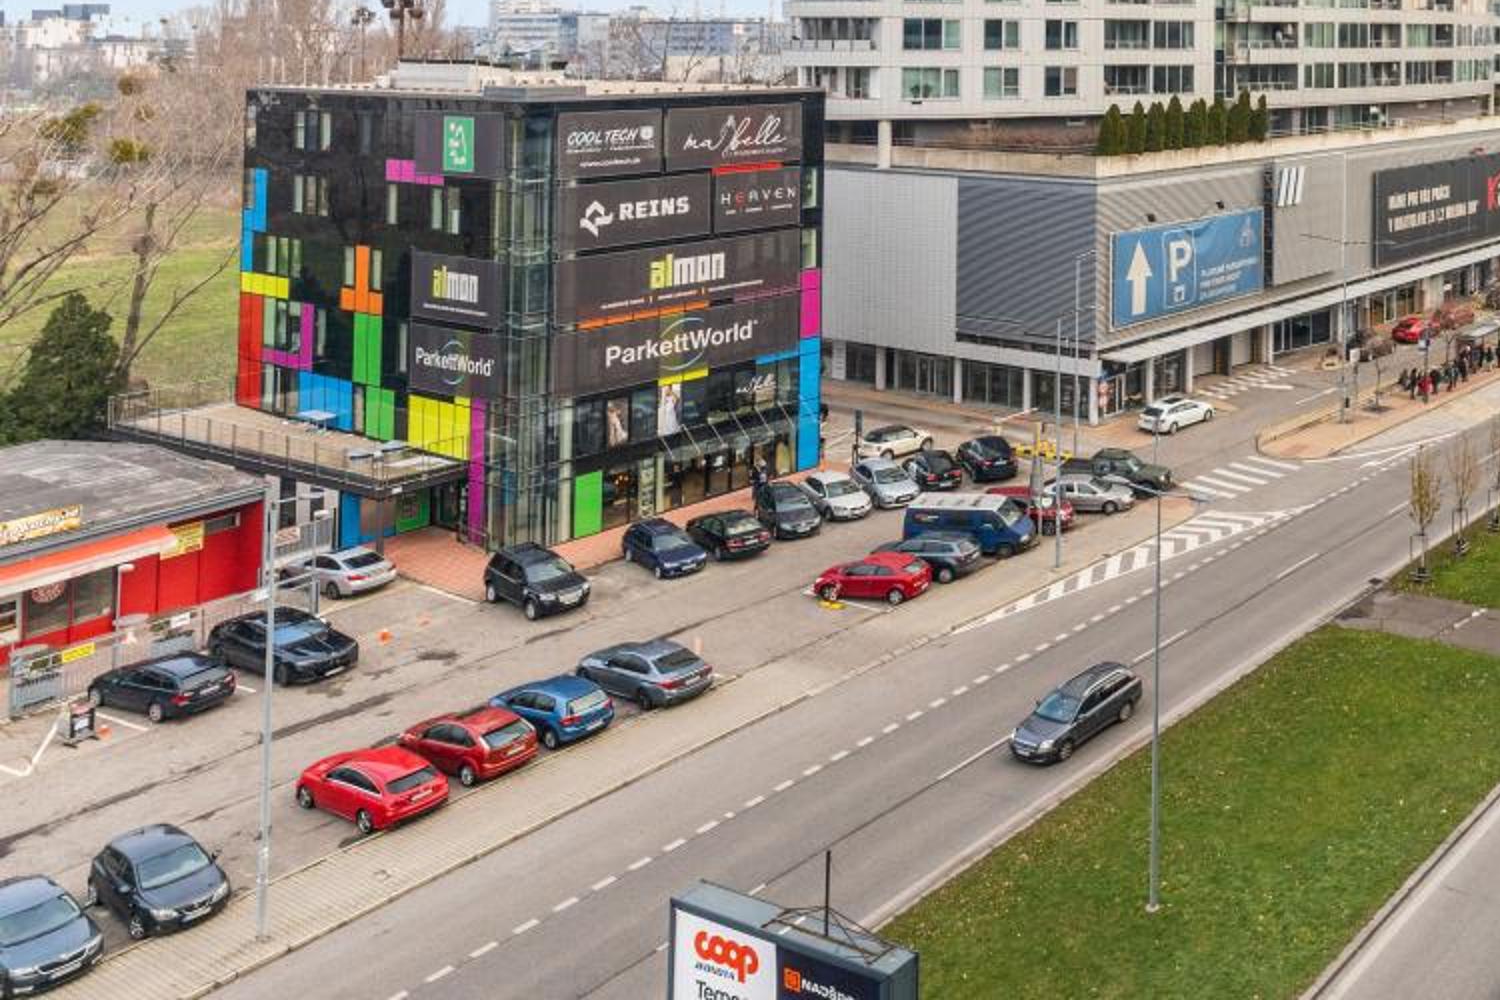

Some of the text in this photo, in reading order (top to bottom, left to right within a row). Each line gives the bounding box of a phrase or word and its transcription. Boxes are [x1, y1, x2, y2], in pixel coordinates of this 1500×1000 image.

[619, 196, 690, 221] REINS
[1169, 240, 1192, 282] P
[415, 347, 491, 376] ParkettWorld
[605, 322, 753, 369] ParkettWorld
[694, 931, 759, 983] coop
